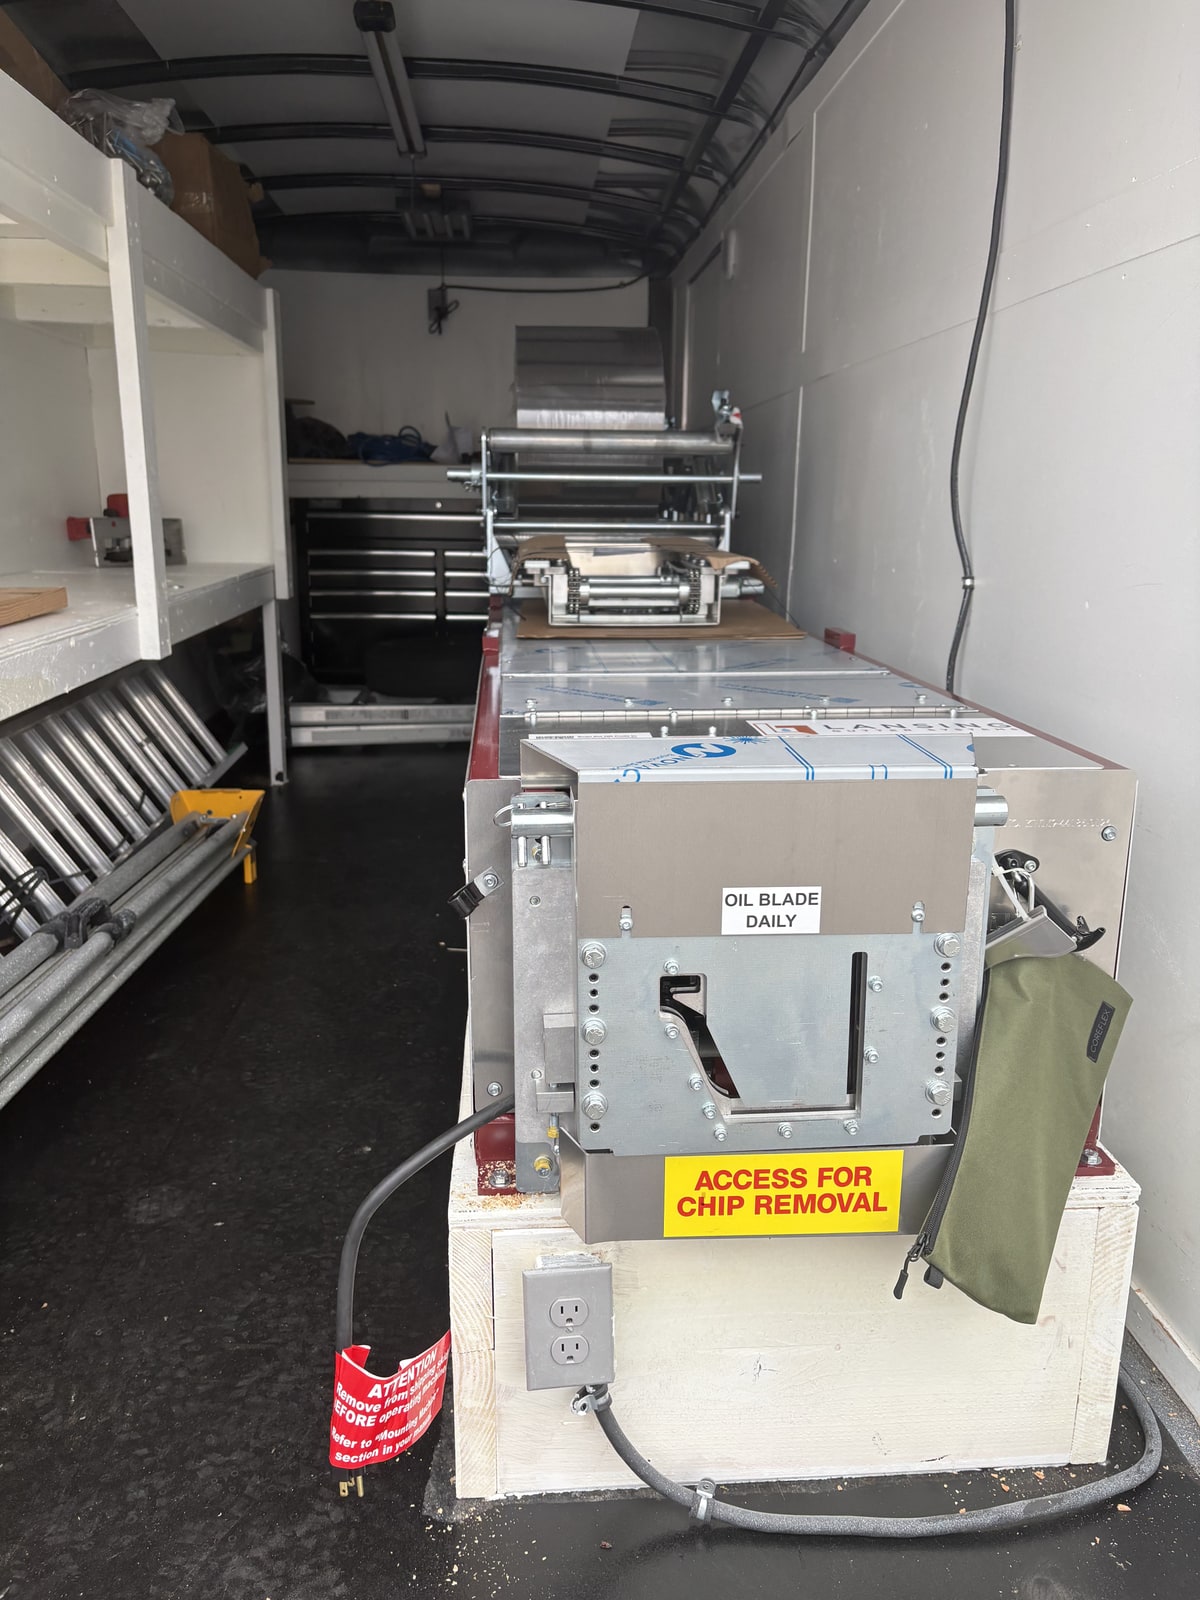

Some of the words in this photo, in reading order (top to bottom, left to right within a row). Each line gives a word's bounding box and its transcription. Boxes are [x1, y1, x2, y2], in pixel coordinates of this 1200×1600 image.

[724, 893, 754, 907] OIL
[759, 892, 819, 907] BLADE
[746, 914, 797, 928] DAILY
[694, 1167, 808, 1191] ACCESS
[817, 1165, 873, 1188] FOR
[676, 1195, 745, 1217] CHIP
[754, 1191, 887, 1216] REMOVAL
[367, 1347, 437, 1399] ATTENTION
[336, 1381, 382, 1413] Remove
[384, 1389, 408, 1410] from
[334, 1396, 377, 1428] EFORE
[335, 1448, 379, 1464] section
[382, 1444, 393, 1456] in
[360, 1439, 373, 1449] to
